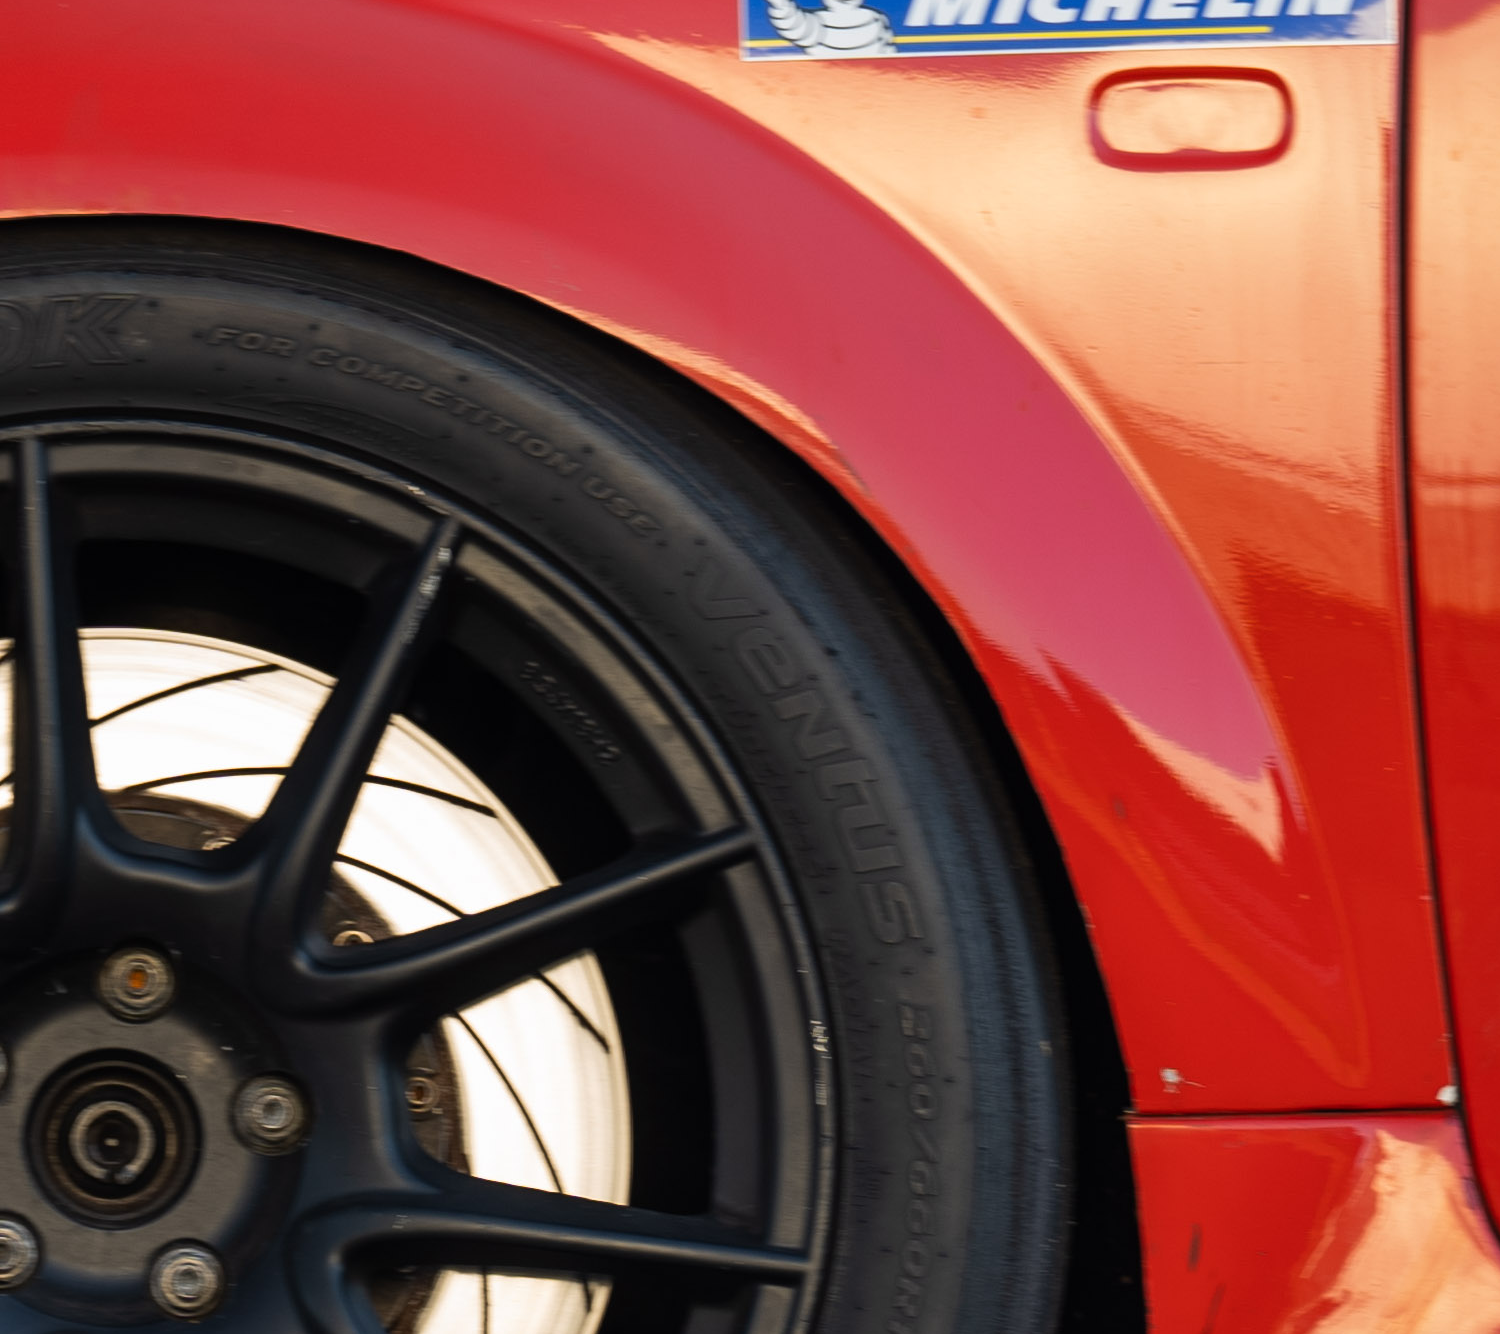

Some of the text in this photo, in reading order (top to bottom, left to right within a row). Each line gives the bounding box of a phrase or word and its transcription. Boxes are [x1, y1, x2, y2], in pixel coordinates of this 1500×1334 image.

[206, 326, 299, 360] FOR
[306, 346, 584, 478] COMPETITION
[581, 474, 665, 539] USE
